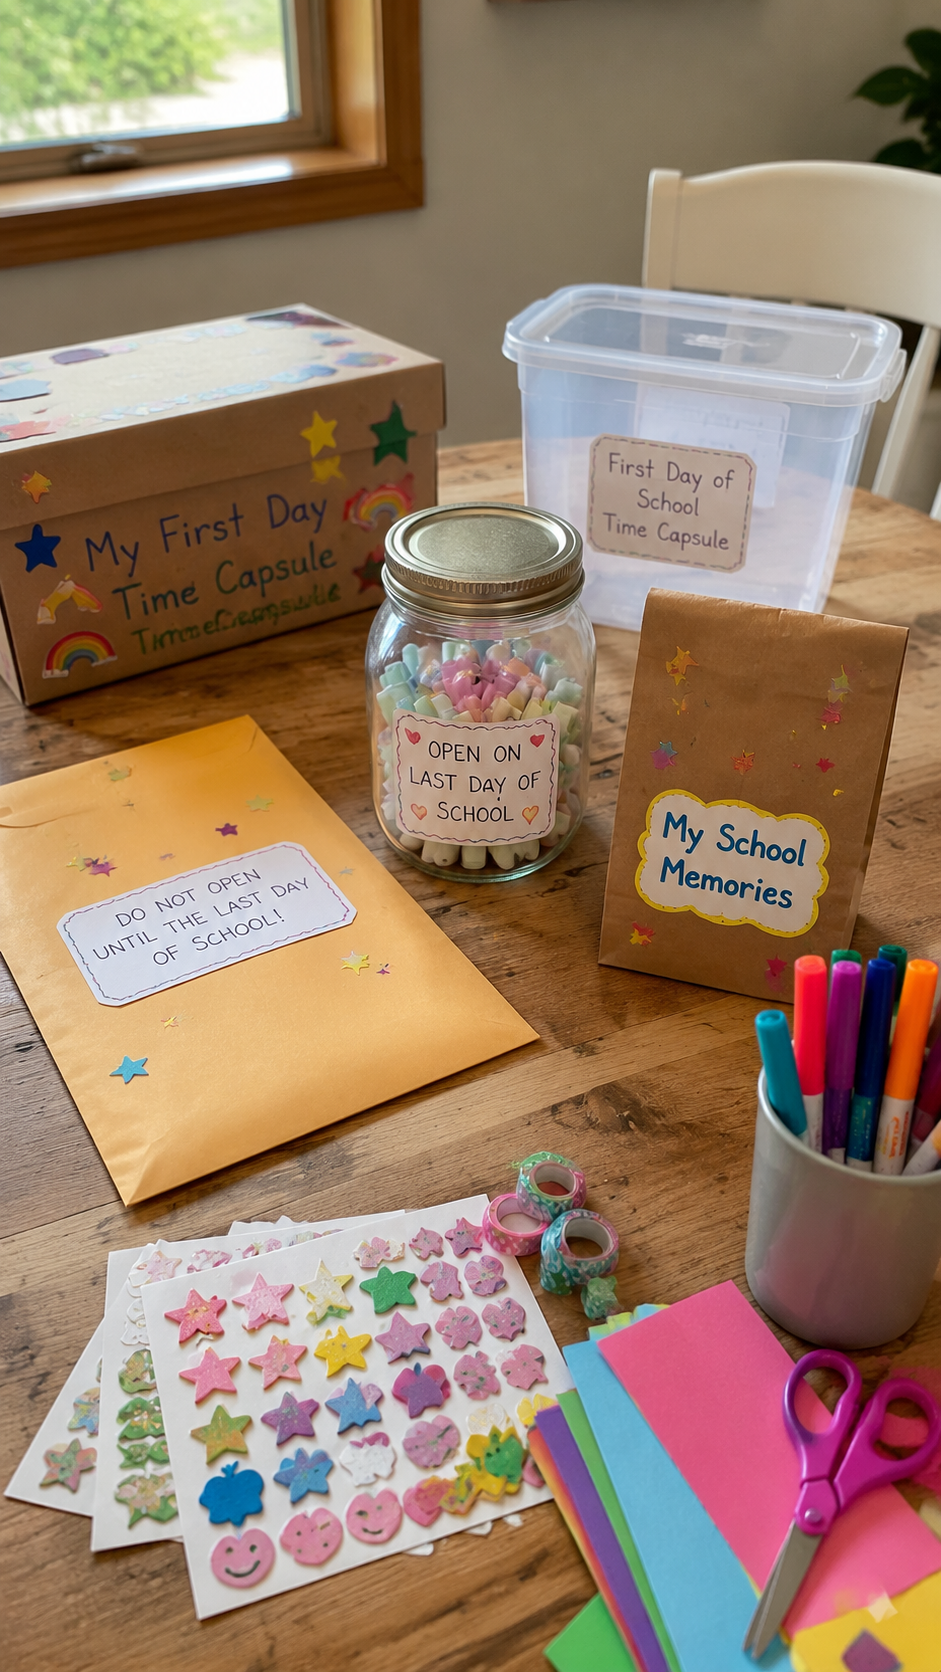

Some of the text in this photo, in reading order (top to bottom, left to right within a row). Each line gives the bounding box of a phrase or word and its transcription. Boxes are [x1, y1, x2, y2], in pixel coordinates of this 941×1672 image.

[609, 452, 736, 494] First Day of
[637, 488, 700, 516] School
[85, 493, 328, 578] My First Day
[602, 512, 730, 551] Time Capsule
[111, 582, 200, 620] Time
[215, 540, 338, 598] Capsule
[428, 740, 521, 763] OPEN ON
[409, 766, 542, 795] LAST DAY OF
[436, 801, 515, 823] SCHOOL
[662, 811, 807, 867] My School
[115, 868, 262, 928] DO NOT OPEN
[659, 856, 793, 909] Memories
[92, 877, 309, 960] UNTIL THE LAST DAY
[152, 908, 286, 966] OF SCHOOL!
